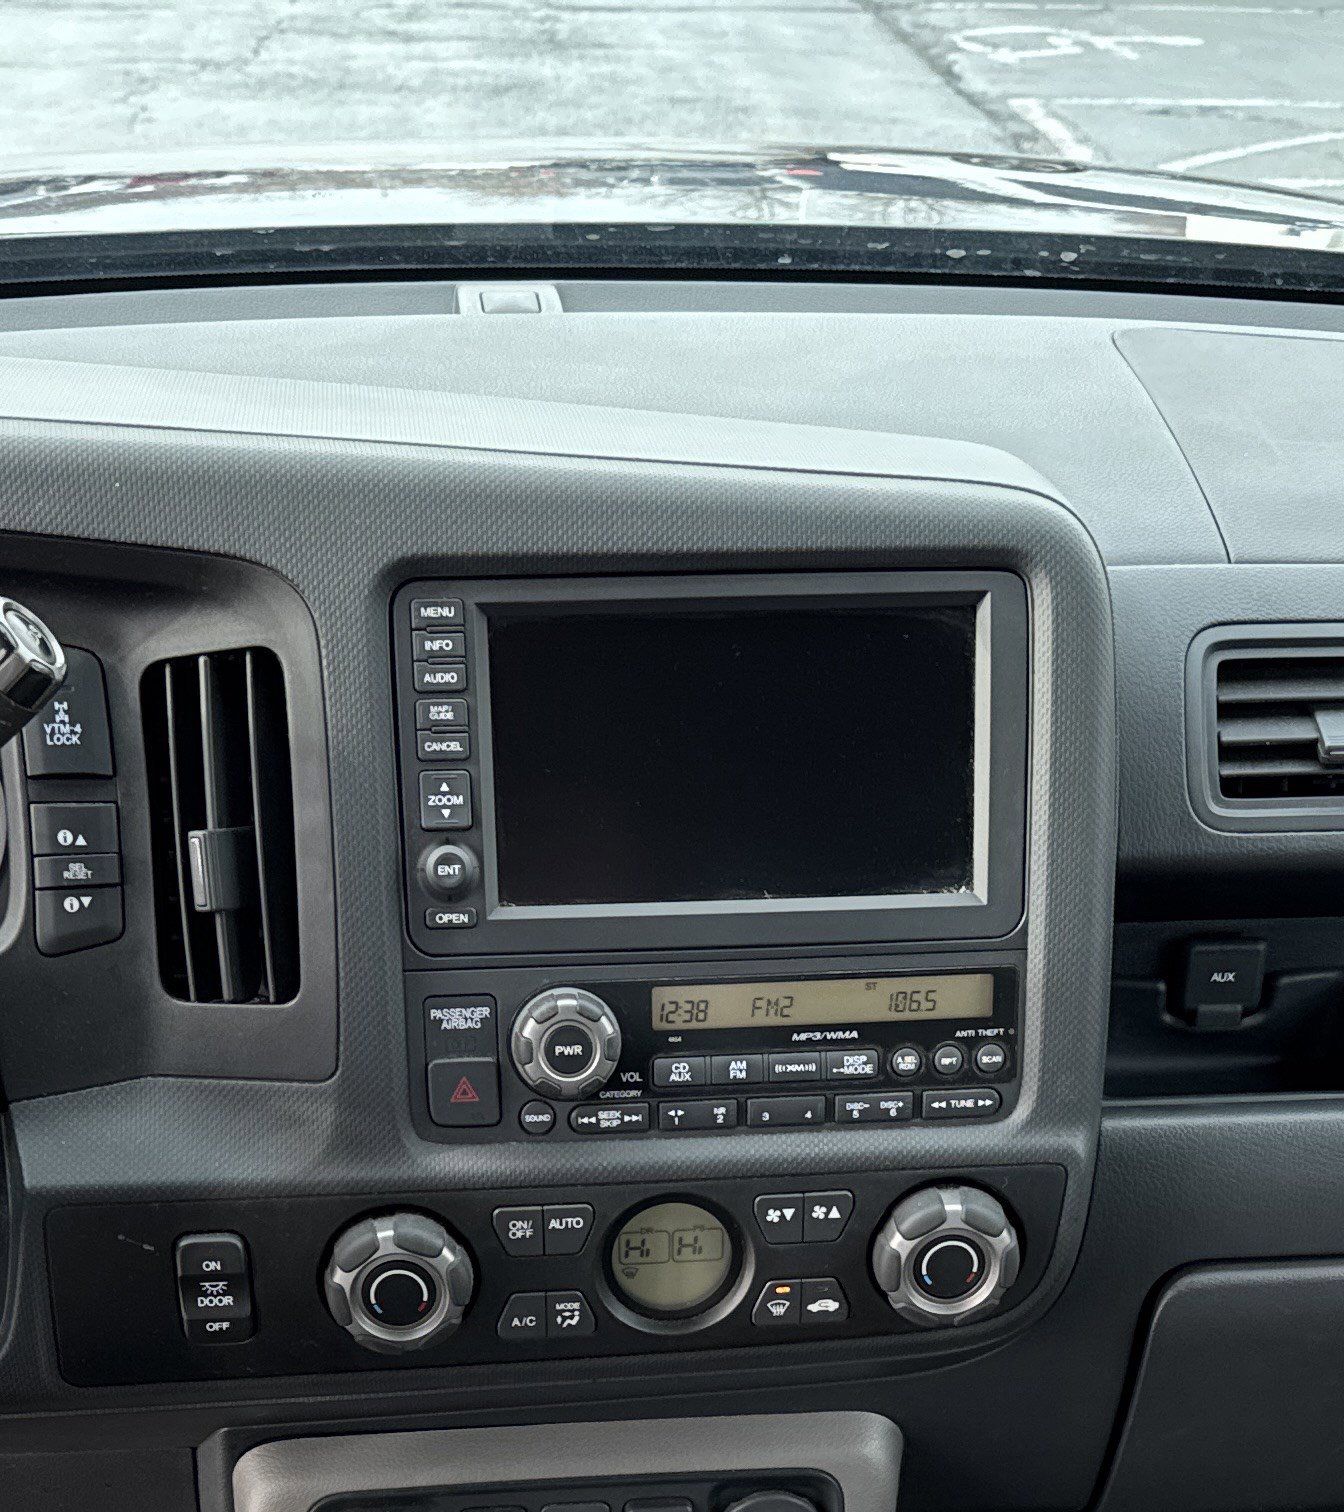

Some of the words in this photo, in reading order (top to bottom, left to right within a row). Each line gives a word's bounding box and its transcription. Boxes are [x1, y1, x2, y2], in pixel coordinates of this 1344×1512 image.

[420, 607, 454, 618] MENU
[425, 640, 452, 651] INFO
[424, 672, 458, 683] AUDIO
[44, 723, 82, 734] VTM-4
[46, 734, 81, 745] LOCK
[424, 741, 464, 751] CANCEL
[427, 795, 464, 805] ZOOM
[63, 870, 93, 880] RESET
[437, 865, 461, 876] ENT
[435, 913, 469, 924] OPEN
[1210, 972, 1236, 982] AUX
[659, 1000, 708, 1024] 12:38
[751, 996, 794, 1018] FM2
[430, 1006, 491, 1020] PASSENGER
[441, 1017, 482, 1030] AIRBAG
[791, 1030, 859, 1041] MP3/WMA
[955, 1029, 975, 1038] ANTI
[978, 1028, 1005, 1037] THEFT
[555, 1045, 583, 1056] PWR
[729, 1060, 747, 1070] AM
[844, 1056, 868, 1065] DISP
[671, 1063, 689, 1073] CD
[844, 1064, 874, 1074] MODE
[620, 1072, 643, 1083] VOL
[669, 1072, 692, 1082] AUX
[730, 1070, 747, 1079] FM
[599, 1089, 642, 1098] CATEGORY
[950, 1099, 975, 1108] TUNE
[524, 1114, 551, 1123] SOUND
[598, 1110, 622, 1119] SEEK
[716, 1115, 724, 1123] 2
[761, 1112, 770, 1121] 3
[805, 1110, 812, 1119] 4
[599, 1118, 622, 1128] SKIP
[509, 1220, 533, 1231] ON/
[548, 1217, 584, 1229] AUTO
[509, 1229, 534, 1239] OFF
[202, 1260, 221, 1271] ON
[197, 1296, 234, 1307] DOOR
[556, 1302, 581, 1310] MODE
[512, 1316, 536, 1327] A/C
[206, 1322, 231, 1332] OFF
